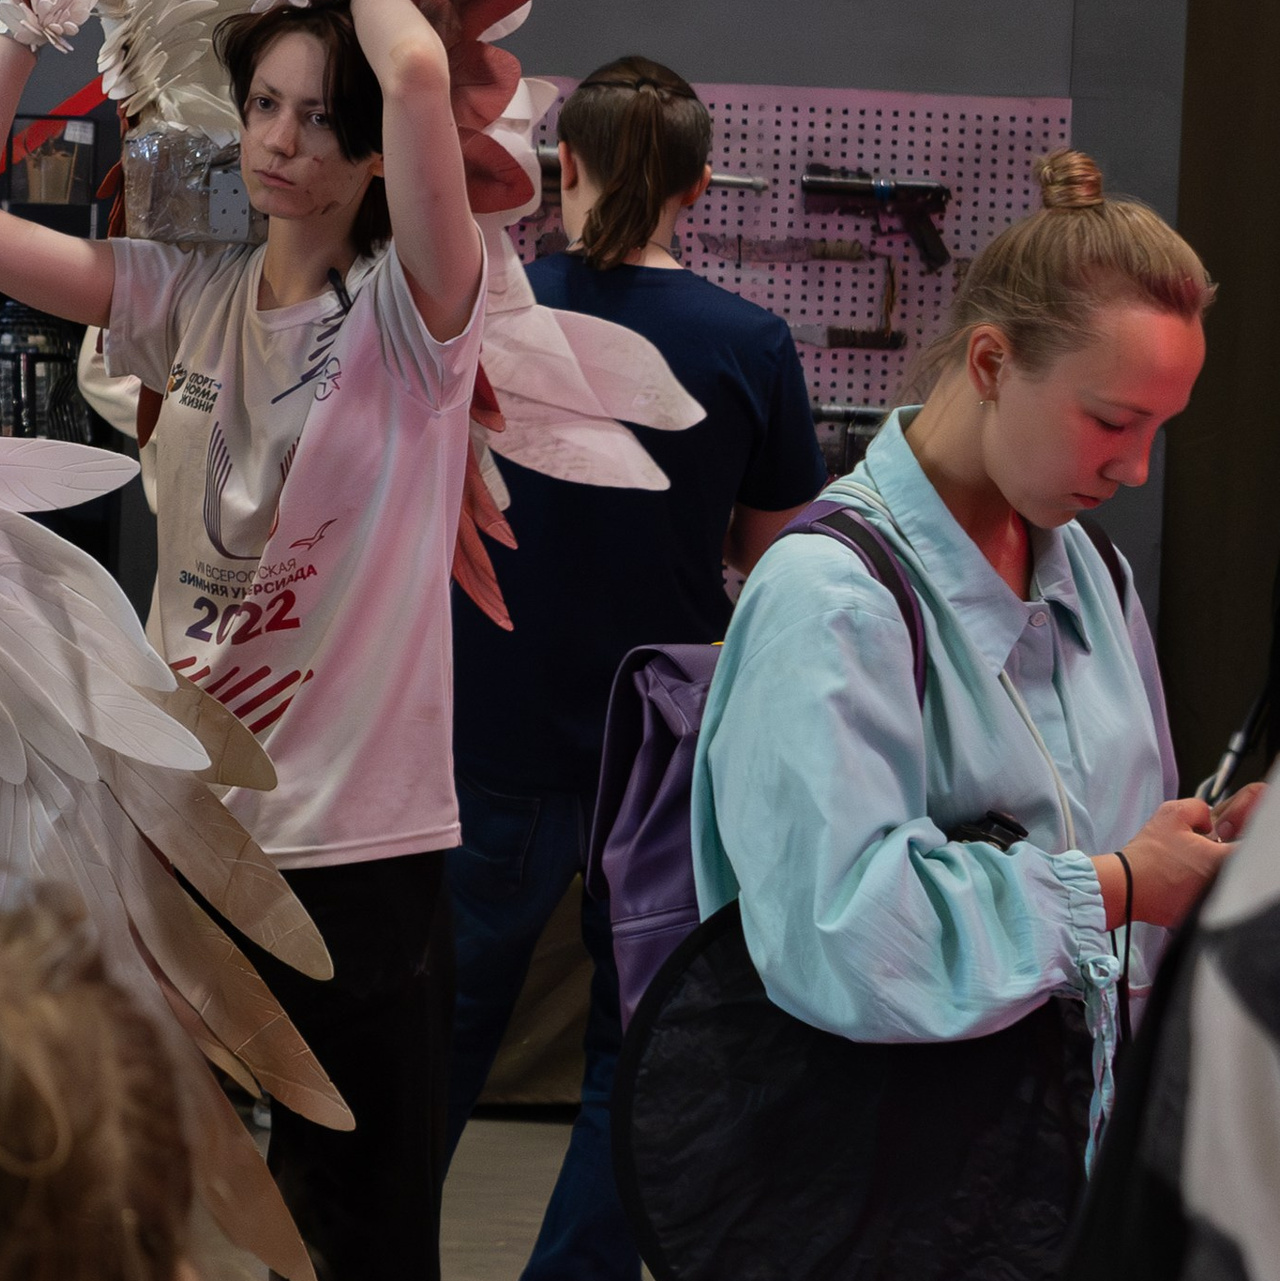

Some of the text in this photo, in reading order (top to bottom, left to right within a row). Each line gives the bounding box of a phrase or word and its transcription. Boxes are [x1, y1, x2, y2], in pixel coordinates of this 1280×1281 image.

[178, 393, 215, 414] ЖИЗНИ
[182, 381, 219, 403] НОРМА
[179, 569, 229, 598] ЗИМНЯЯ
[184, 589, 301, 645] 2022
